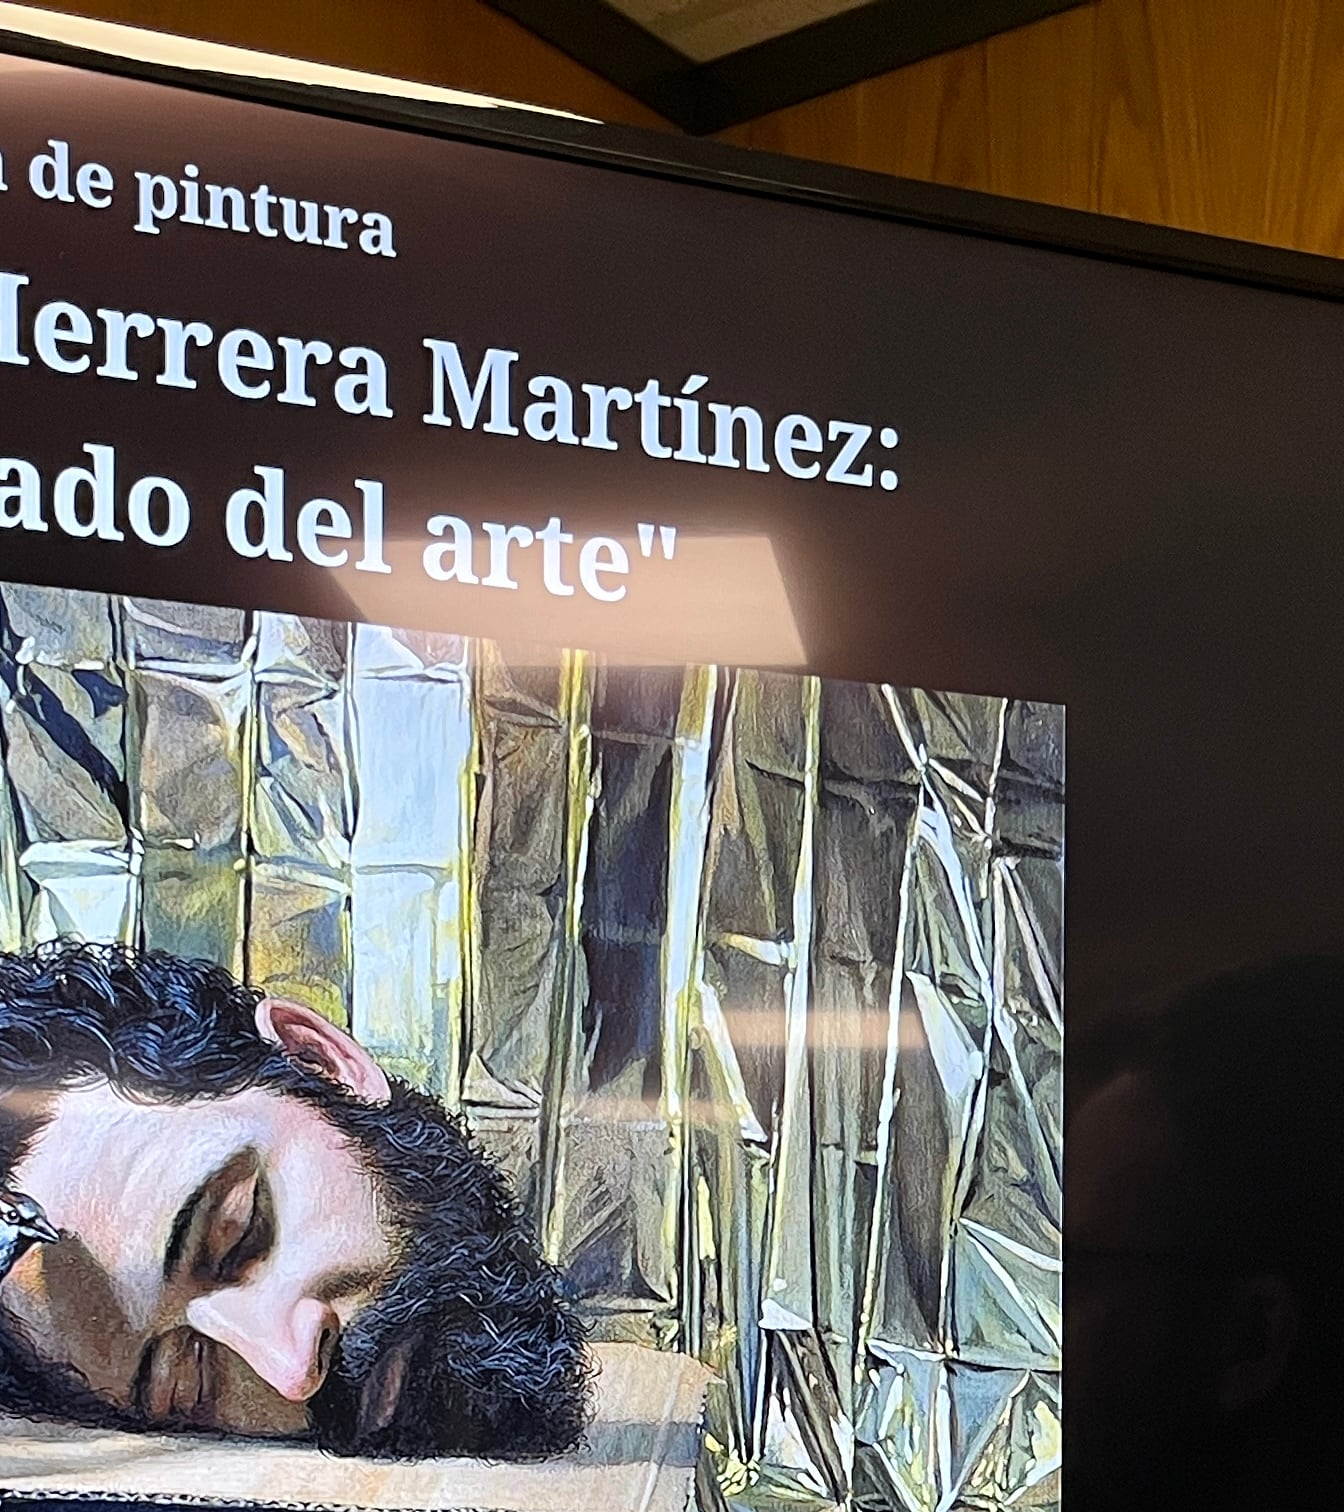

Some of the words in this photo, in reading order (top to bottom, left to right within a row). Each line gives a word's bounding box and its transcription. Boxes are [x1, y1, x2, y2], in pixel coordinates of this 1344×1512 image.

[28, 139, 114, 208] de
[133, 163, 397, 258] pintura
[422, 338, 902, 491] Martínez:
[225, 466, 390, 575] del
[422, 514, 679, 602] arte"
